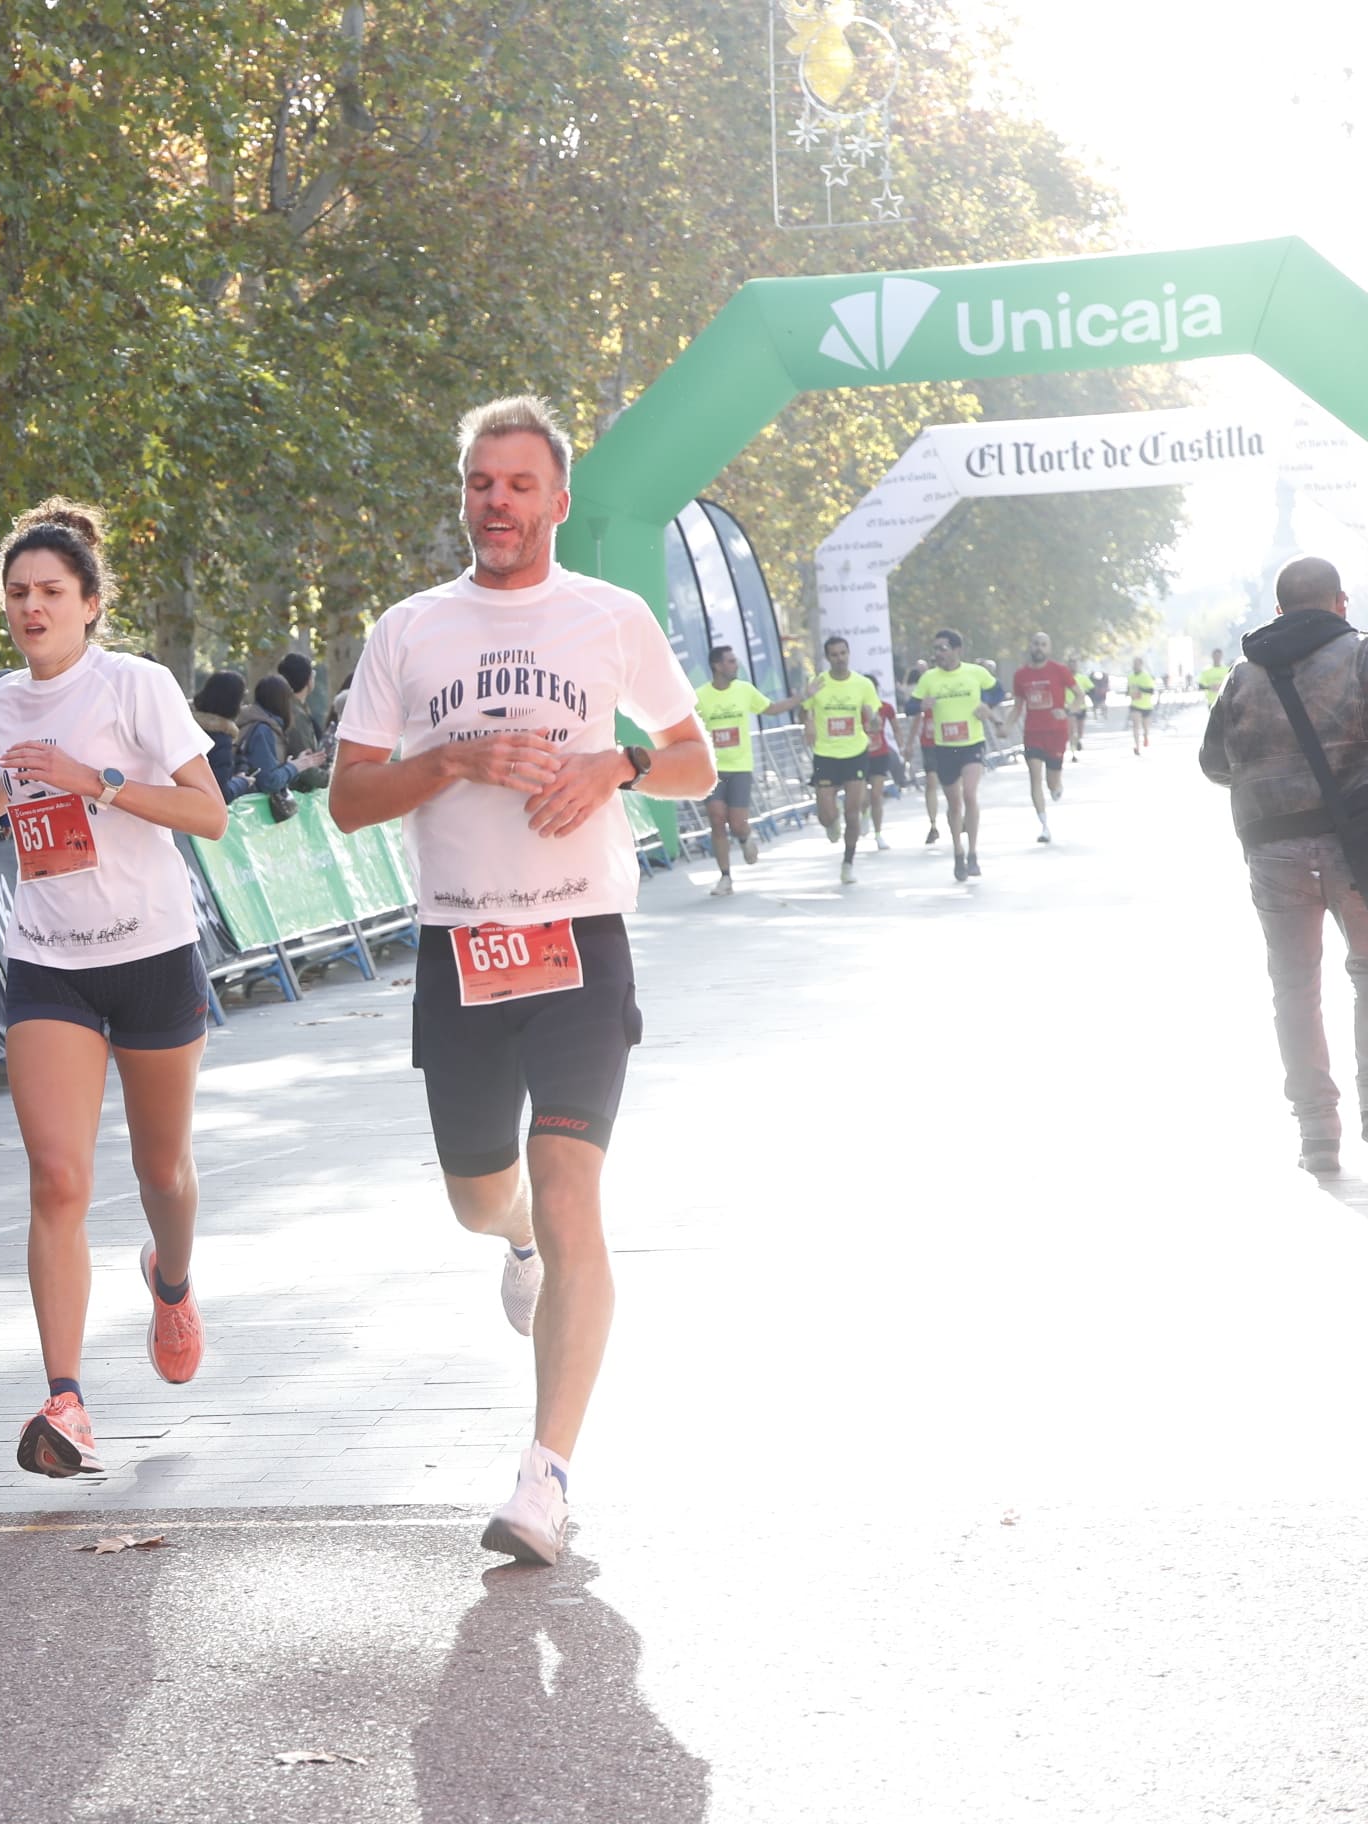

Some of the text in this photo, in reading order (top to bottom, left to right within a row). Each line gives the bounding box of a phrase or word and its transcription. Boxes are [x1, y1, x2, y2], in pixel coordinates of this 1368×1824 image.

[956, 281, 1223, 356] Unicaja
[965, 424, 1265, 478] El Norte de Castilla
[480, 649, 537, 667] HOSPITAL
[429, 667, 588, 729] RIO HORTEGA
[18, 814, 55, 852] 651
[468, 933, 530, 971] 650
